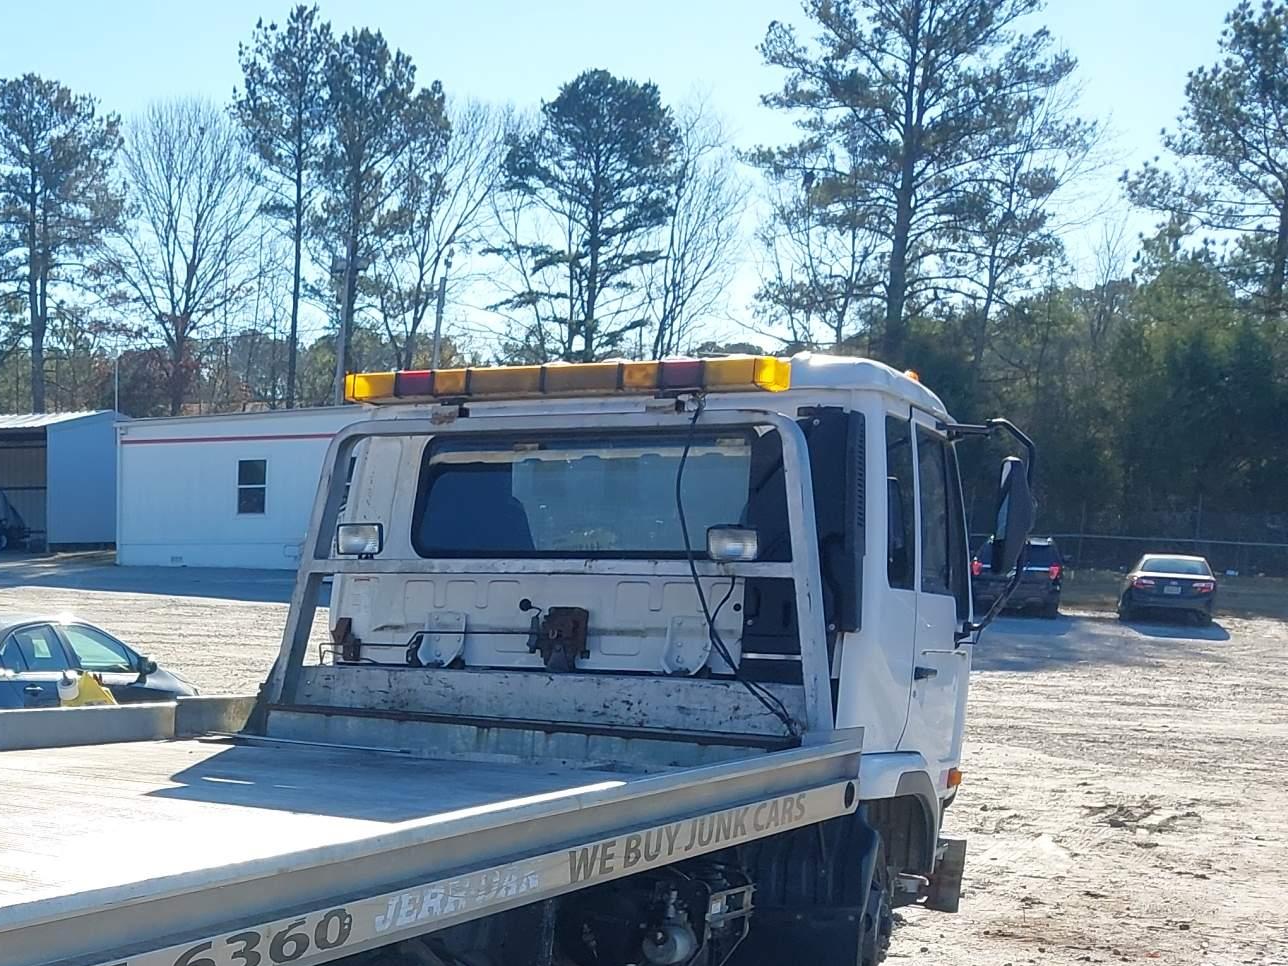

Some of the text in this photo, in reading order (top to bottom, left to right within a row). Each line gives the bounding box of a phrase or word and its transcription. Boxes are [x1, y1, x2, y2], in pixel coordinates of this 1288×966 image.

[568, 793, 806, 884] WE BUY JUNK CARS
